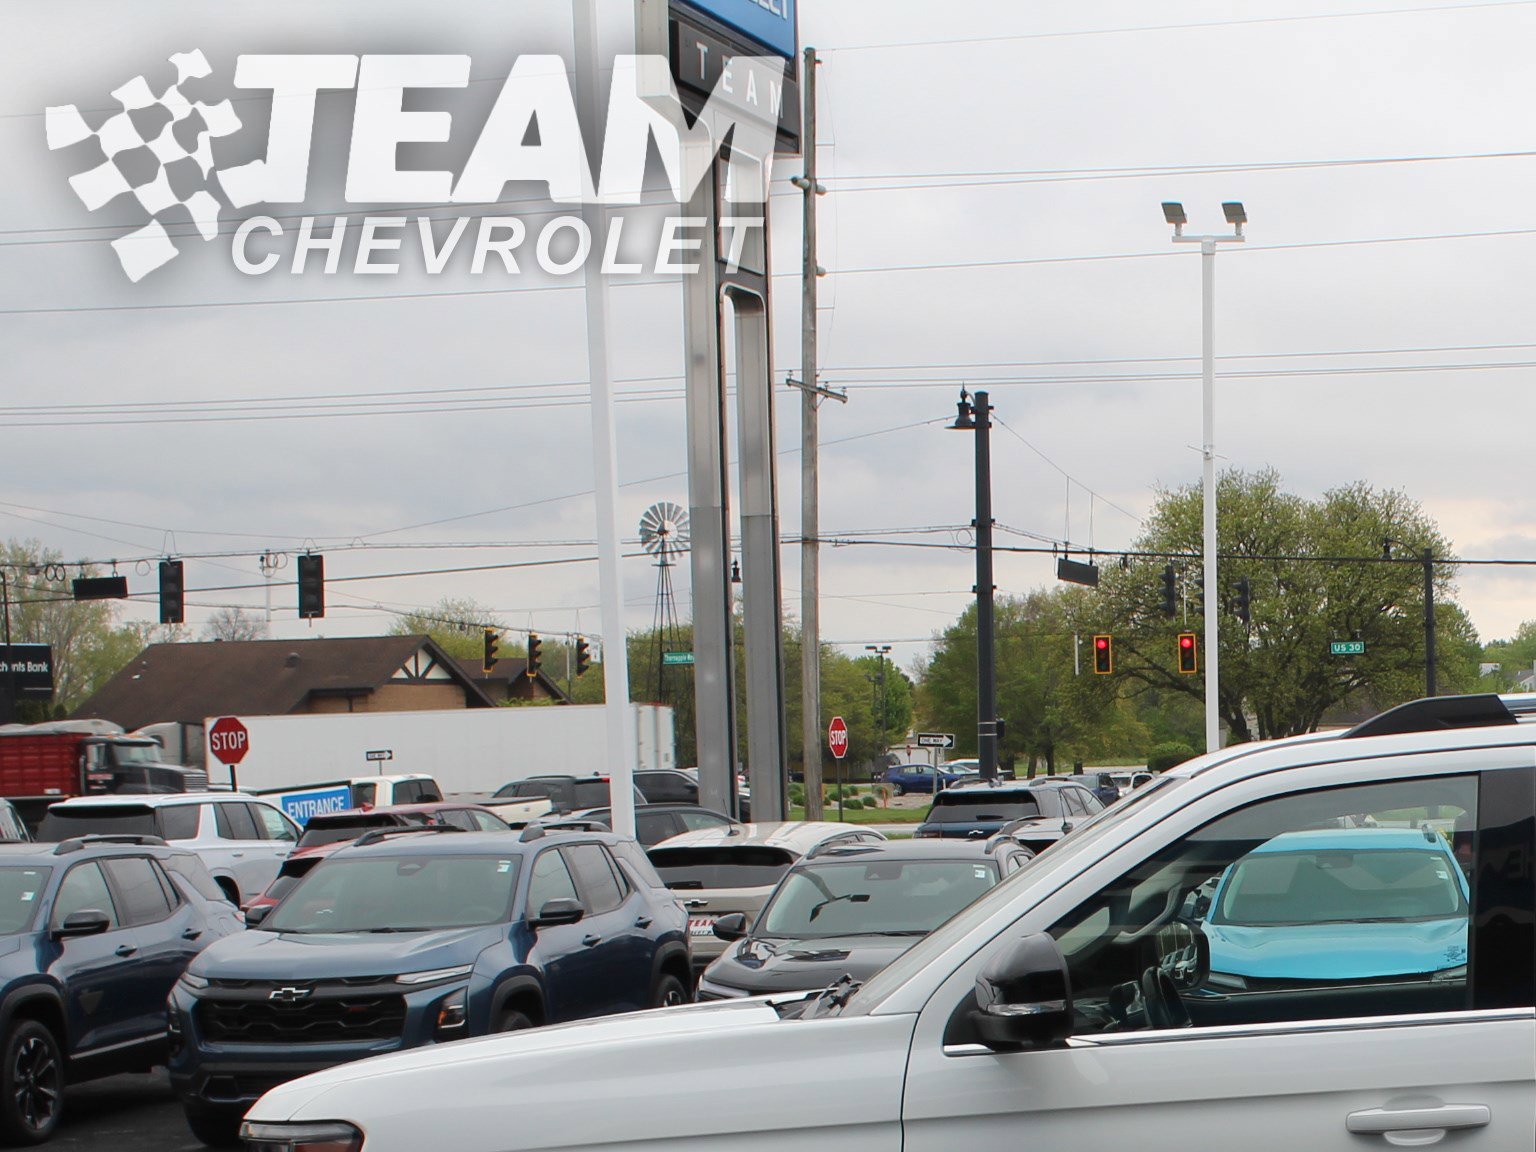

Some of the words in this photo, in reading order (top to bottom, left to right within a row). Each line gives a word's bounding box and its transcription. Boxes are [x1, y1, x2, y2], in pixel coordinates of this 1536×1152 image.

[695, 42, 784, 119] TEAM
[1334, 644, 1347, 652] US
[1349, 643, 1361, 651] 30
[27, 661, 49, 673] Bank
[211, 731, 246, 750] STOP
[830, 730, 846, 746] STOP
[287, 796, 345, 820] ENTRANCE
